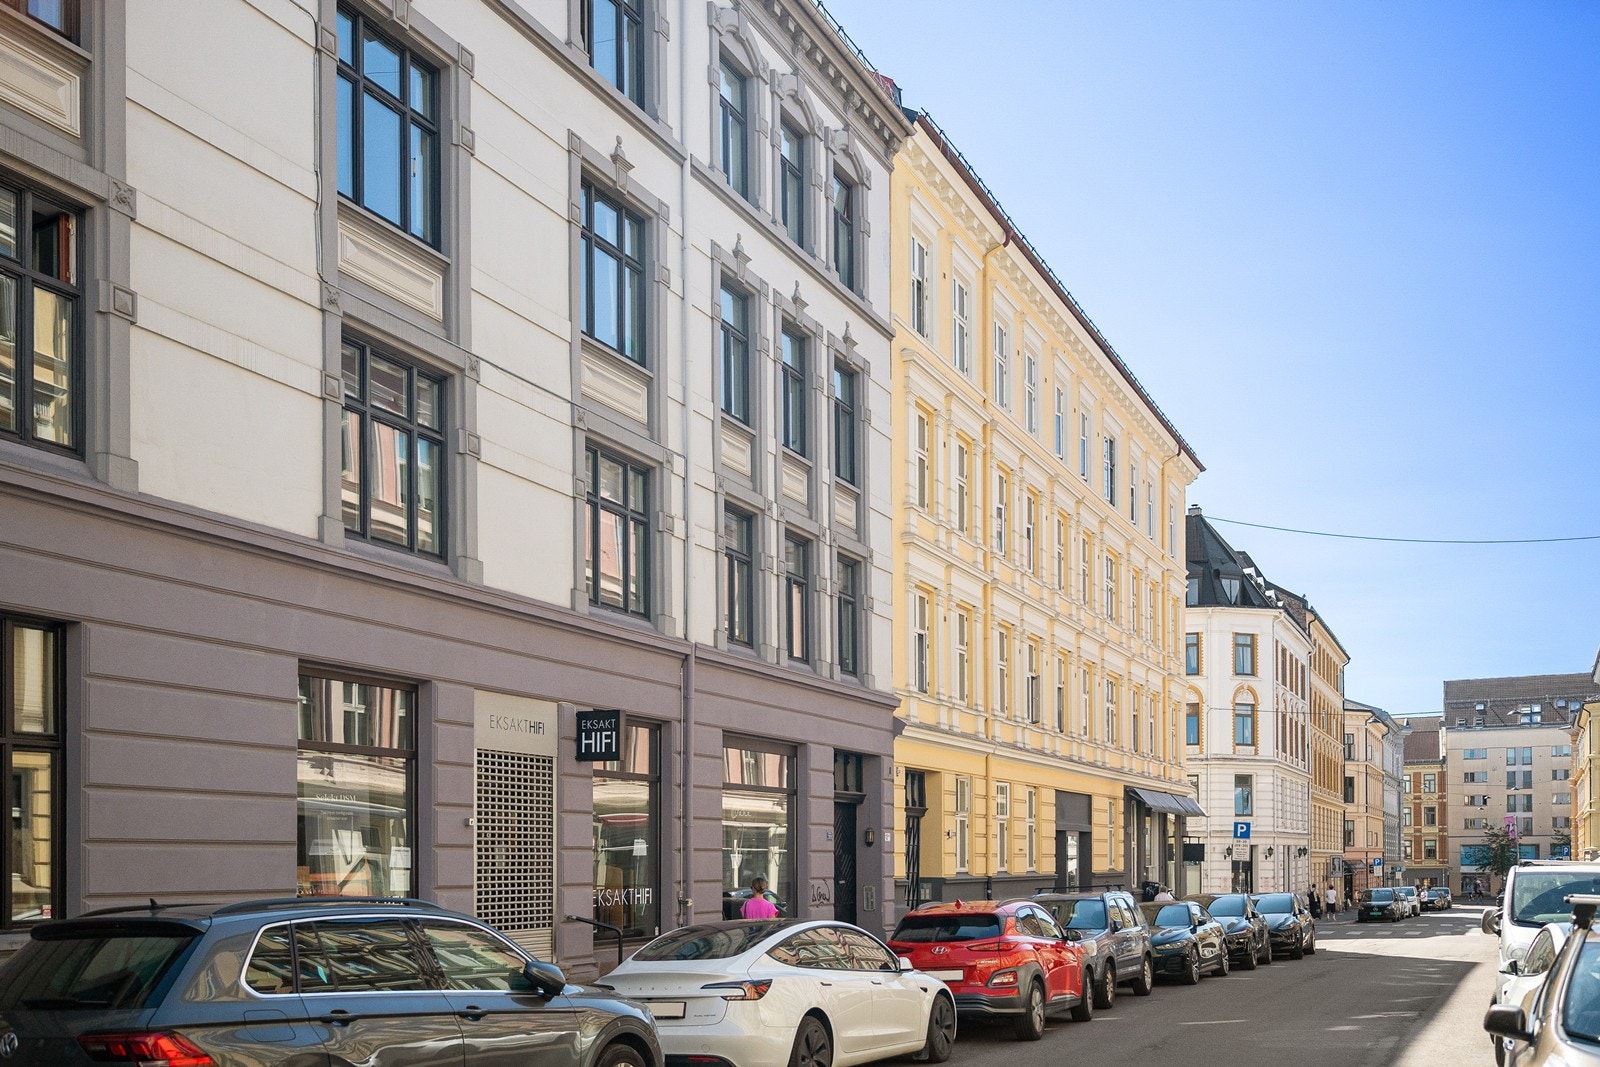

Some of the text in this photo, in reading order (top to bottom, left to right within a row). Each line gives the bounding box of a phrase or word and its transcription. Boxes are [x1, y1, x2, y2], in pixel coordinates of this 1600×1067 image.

[489, 714, 545, 736] EKSAKTHIFI
[581, 718, 616, 730] EKSAKT
[581, 731, 616, 753] HIFI
[1237, 824, 1246, 836] P
